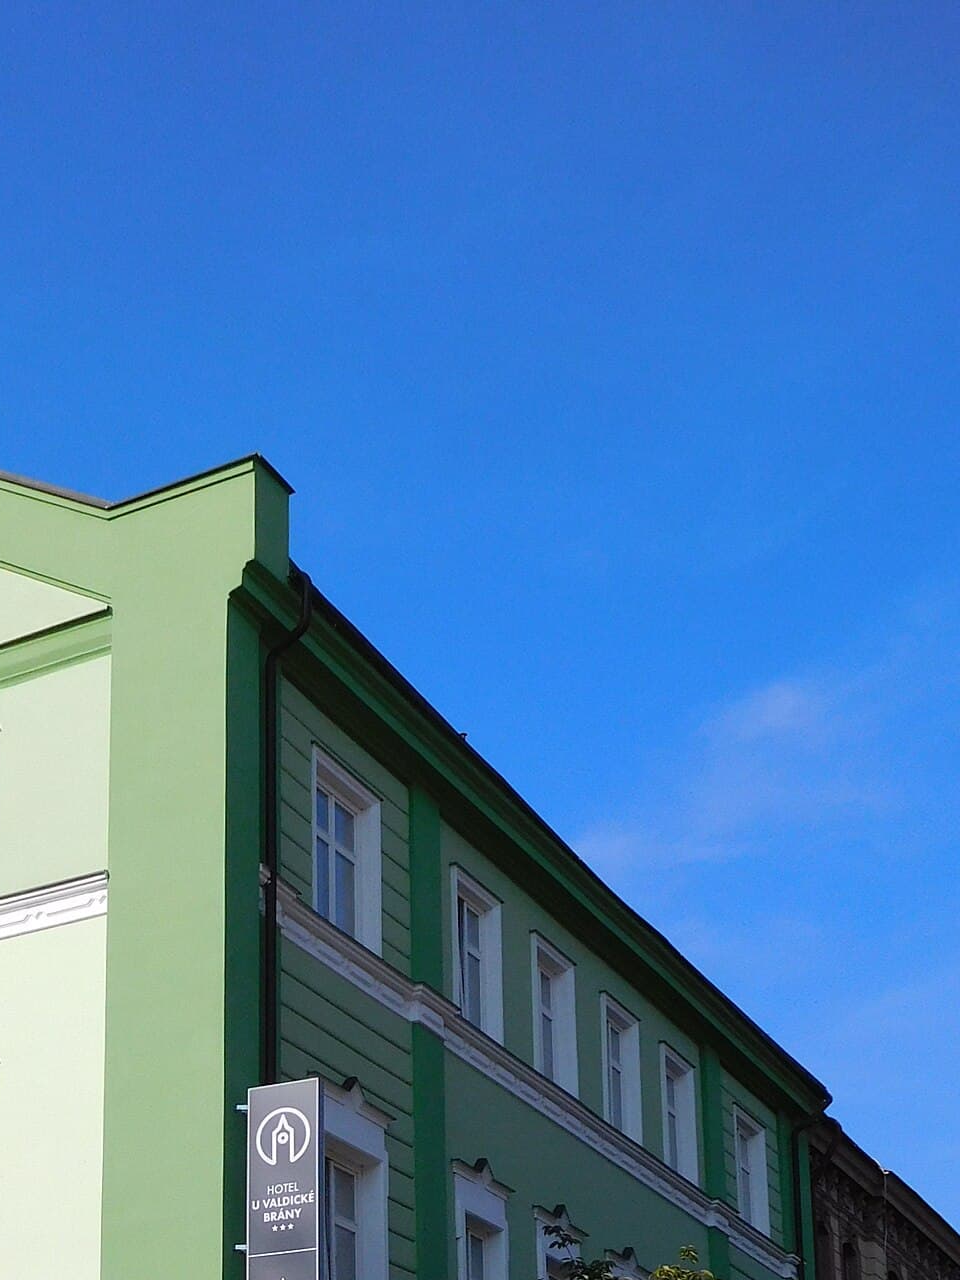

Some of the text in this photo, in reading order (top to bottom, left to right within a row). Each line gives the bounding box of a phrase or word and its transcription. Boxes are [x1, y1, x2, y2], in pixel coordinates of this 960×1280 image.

[267, 1182, 299, 1196] HOTEL
[252, 1190, 315, 1210] U VALDICKÉ
[263, 1207, 302, 1223] BRÁNY
